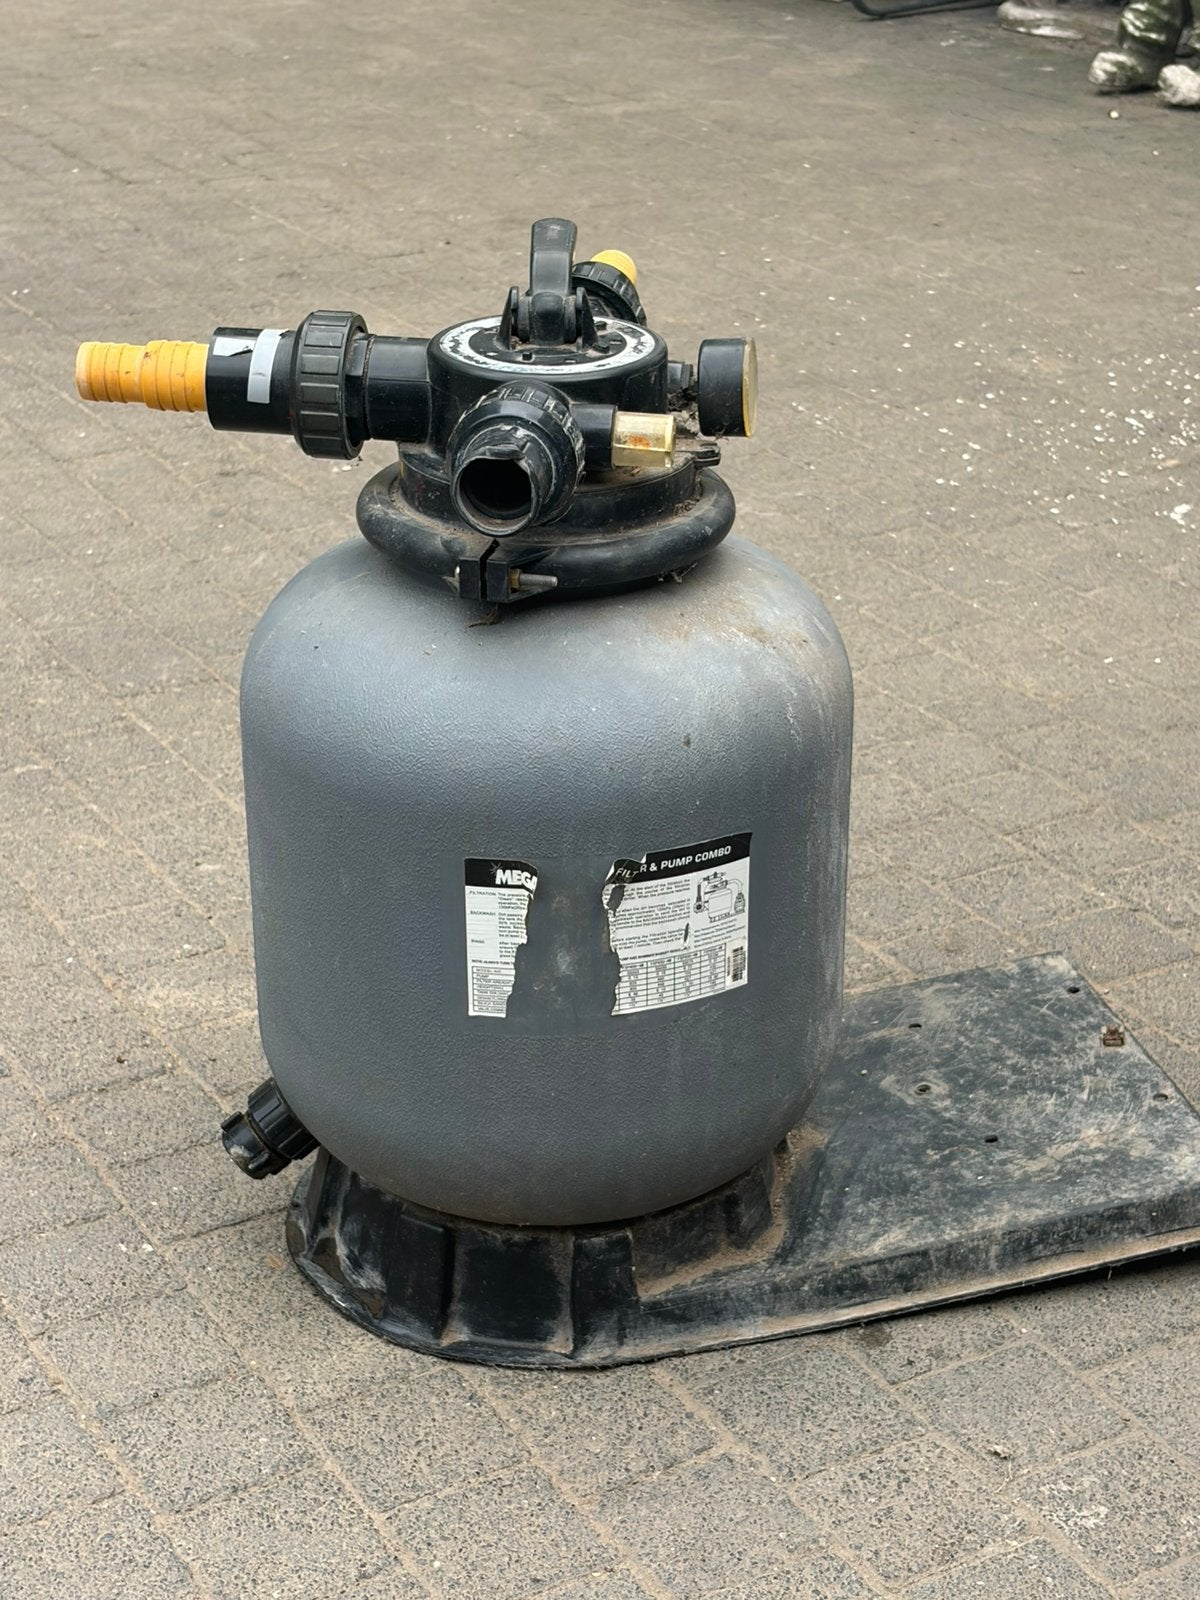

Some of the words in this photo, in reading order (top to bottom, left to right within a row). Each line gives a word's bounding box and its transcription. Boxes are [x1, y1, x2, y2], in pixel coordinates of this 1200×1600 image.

[615, 863, 647, 878] FILTR
[649, 863, 657, 871] &
[660, 855, 693, 870] PUMP
[695, 845, 732, 863] COMBO
